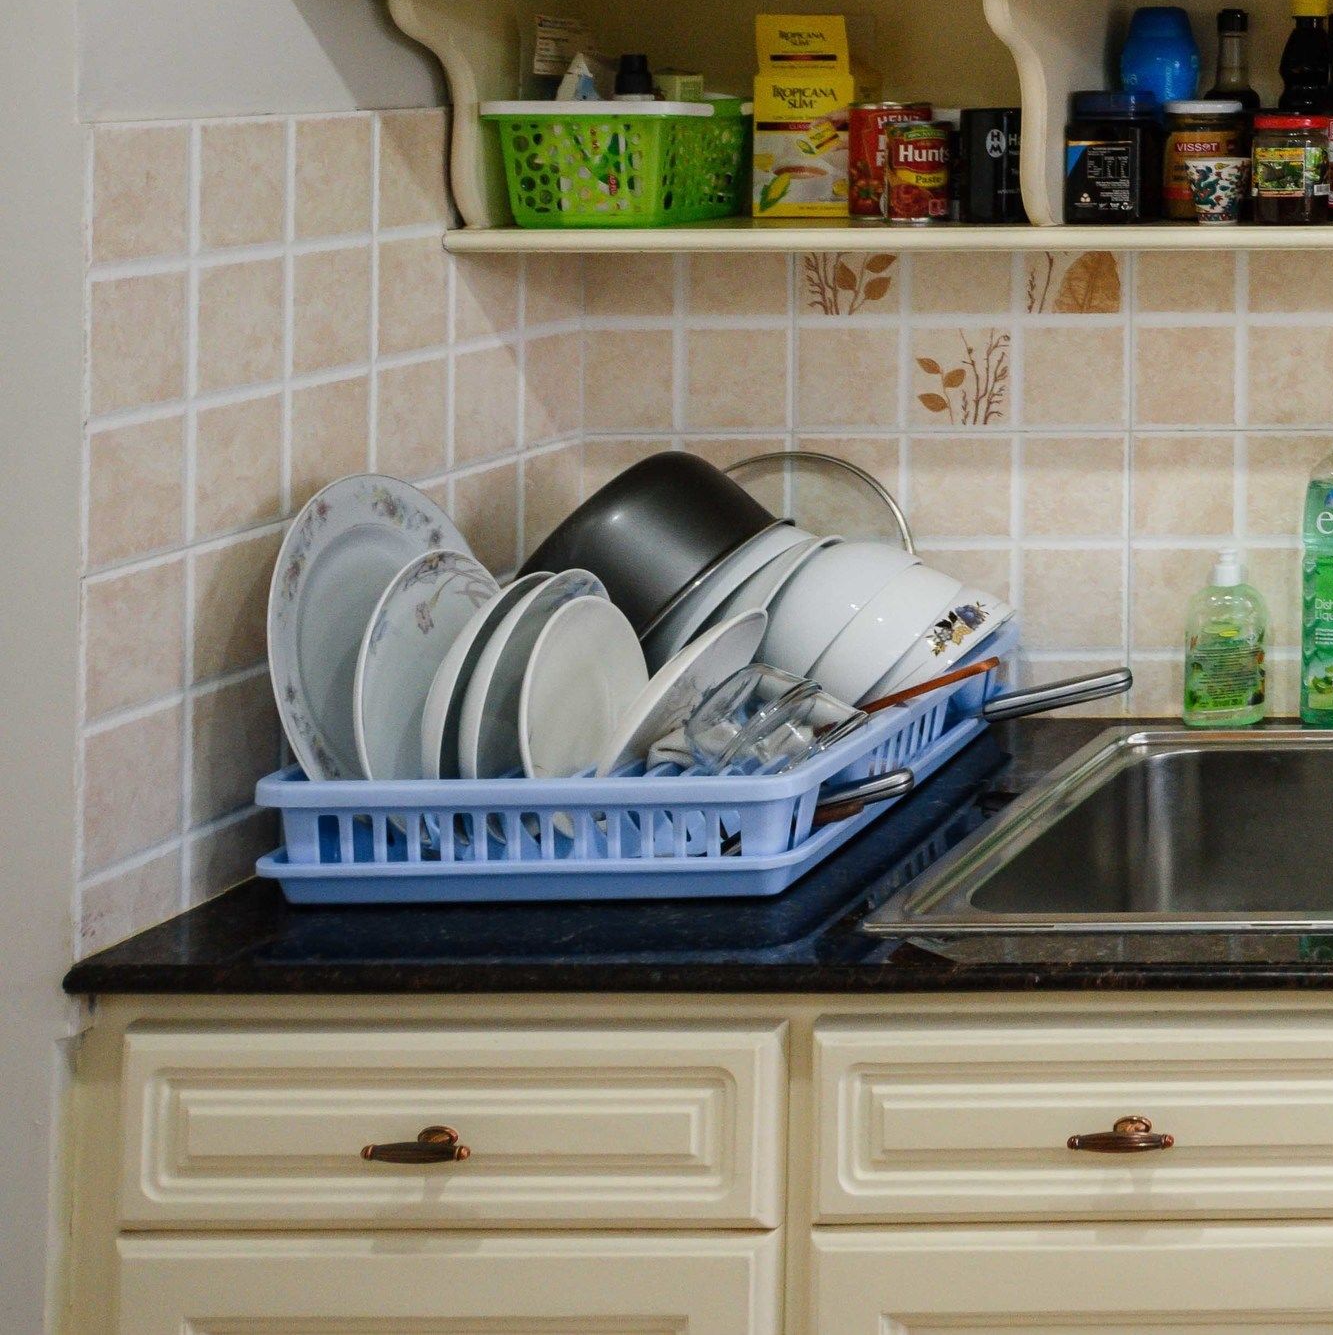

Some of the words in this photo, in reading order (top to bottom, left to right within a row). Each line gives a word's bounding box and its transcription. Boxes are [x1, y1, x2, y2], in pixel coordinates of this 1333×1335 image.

[772, 85, 838, 101] TROPICANA
[788, 98, 815, 109] SLIM
[1177, 142, 1218, 152] VISSOT
